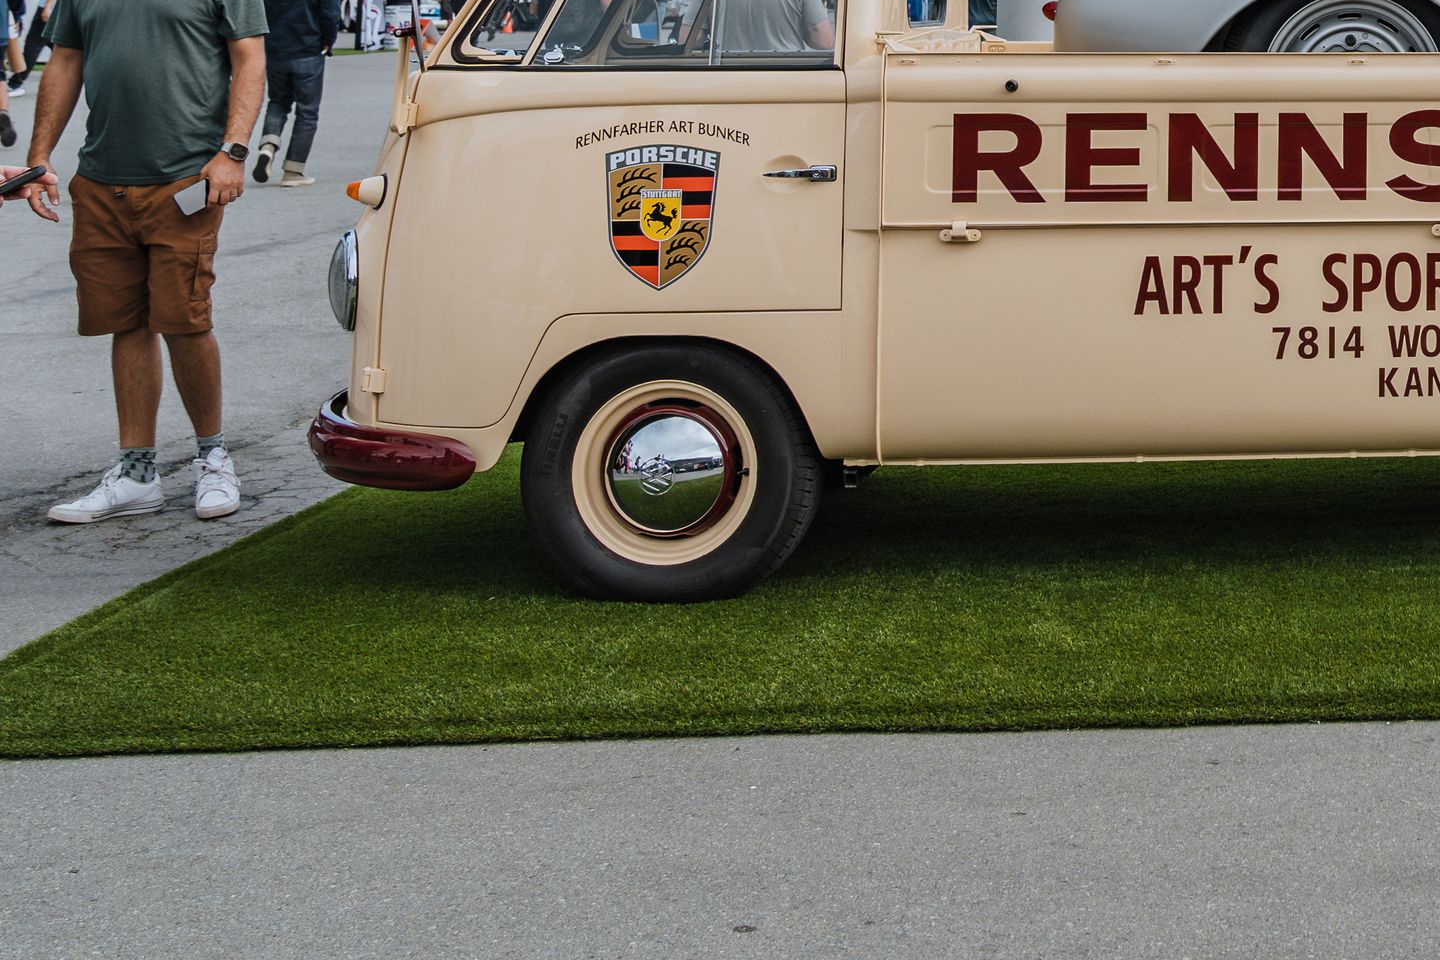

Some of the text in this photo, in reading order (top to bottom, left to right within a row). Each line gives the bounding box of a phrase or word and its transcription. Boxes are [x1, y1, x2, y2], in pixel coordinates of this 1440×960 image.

[575, 121, 750, 149] RENNFARHER ART BUNKER
[610, 147, 716, 170] PORSCHE
[642, 190, 681, 198] STUTTGART
[1134, 246, 1280, 315] ART'S
[1272, 326, 1364, 359] 7814
